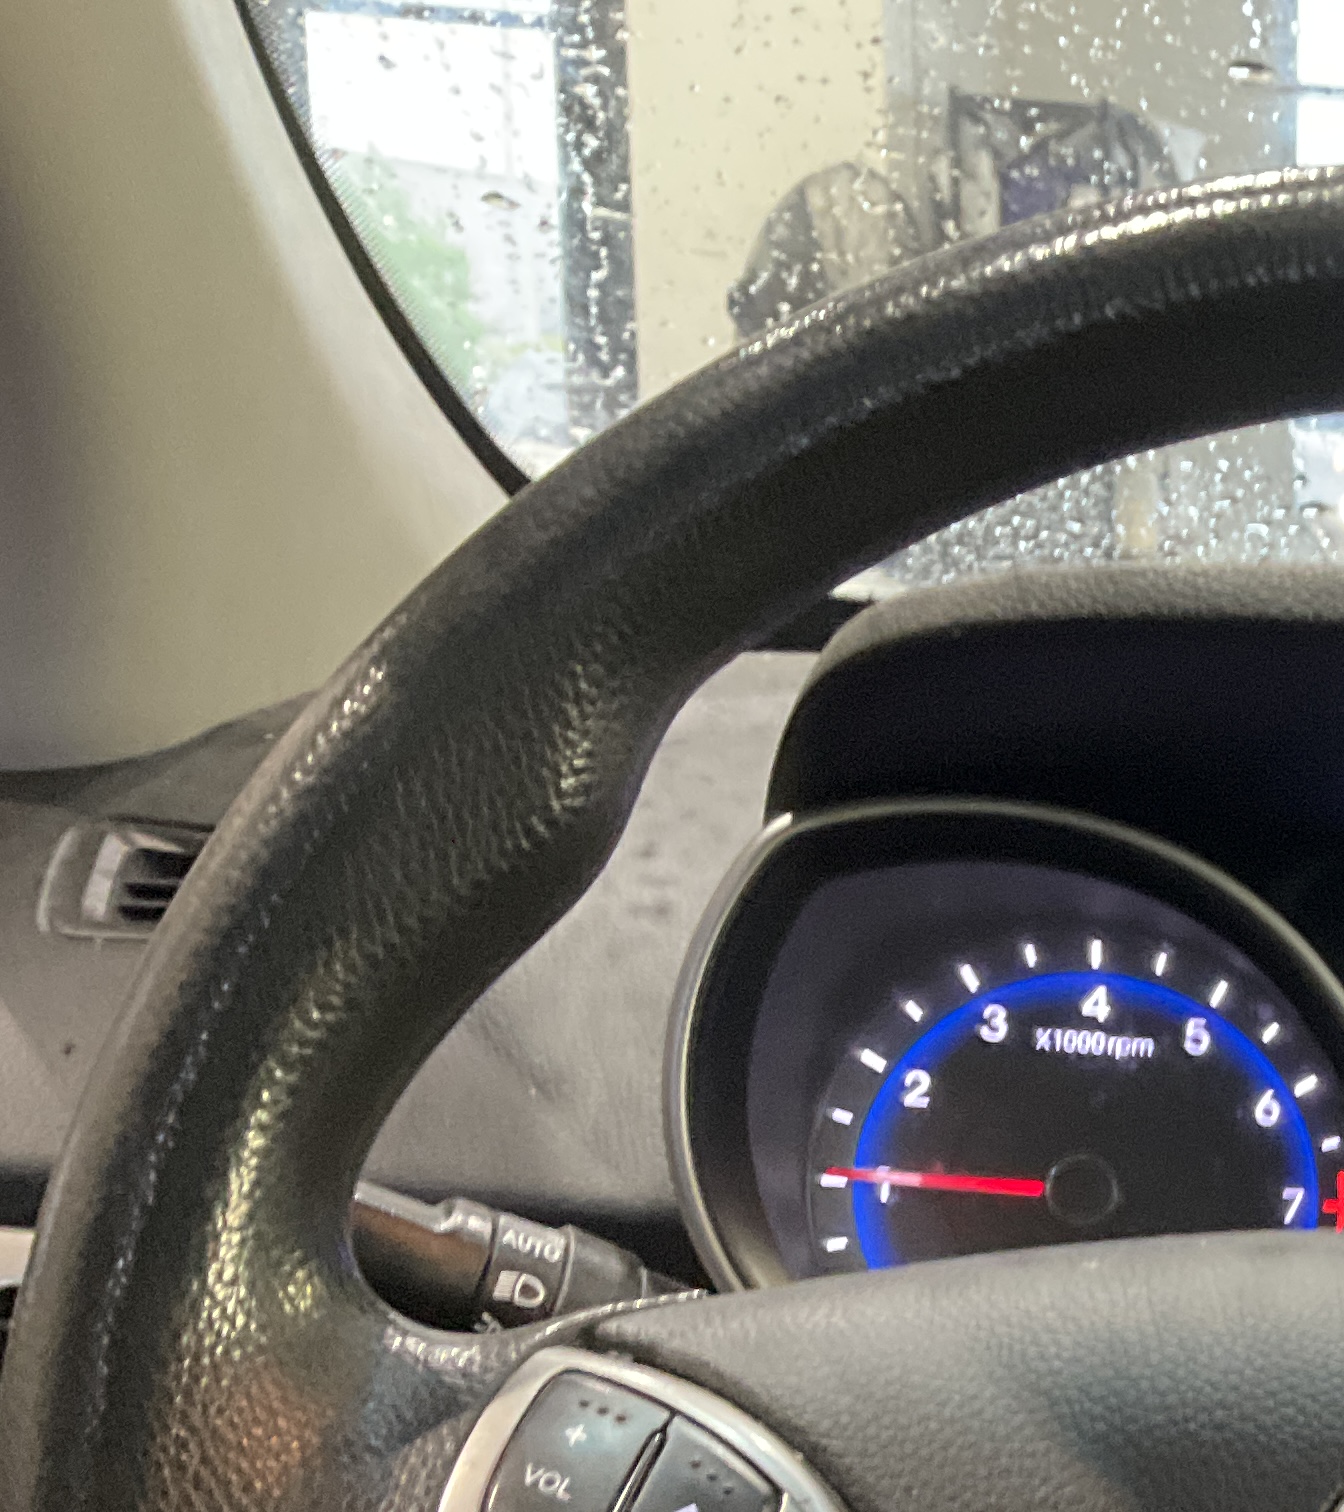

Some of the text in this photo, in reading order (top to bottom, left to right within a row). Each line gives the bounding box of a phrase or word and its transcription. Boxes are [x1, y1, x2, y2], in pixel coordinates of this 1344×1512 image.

[1081, 985, 1110, 1022] 4
[979, 1004, 1008, 1042] 3
[1183, 1018, 1210, 1057] 5
[903, 1068, 931, 1108] 2
[1254, 1089, 1281, 1127] 6
[1281, 1187, 1305, 1226] 7
[502, 1228, 566, 1264] AUTO
[522, 1462, 572, 1501] VOL
